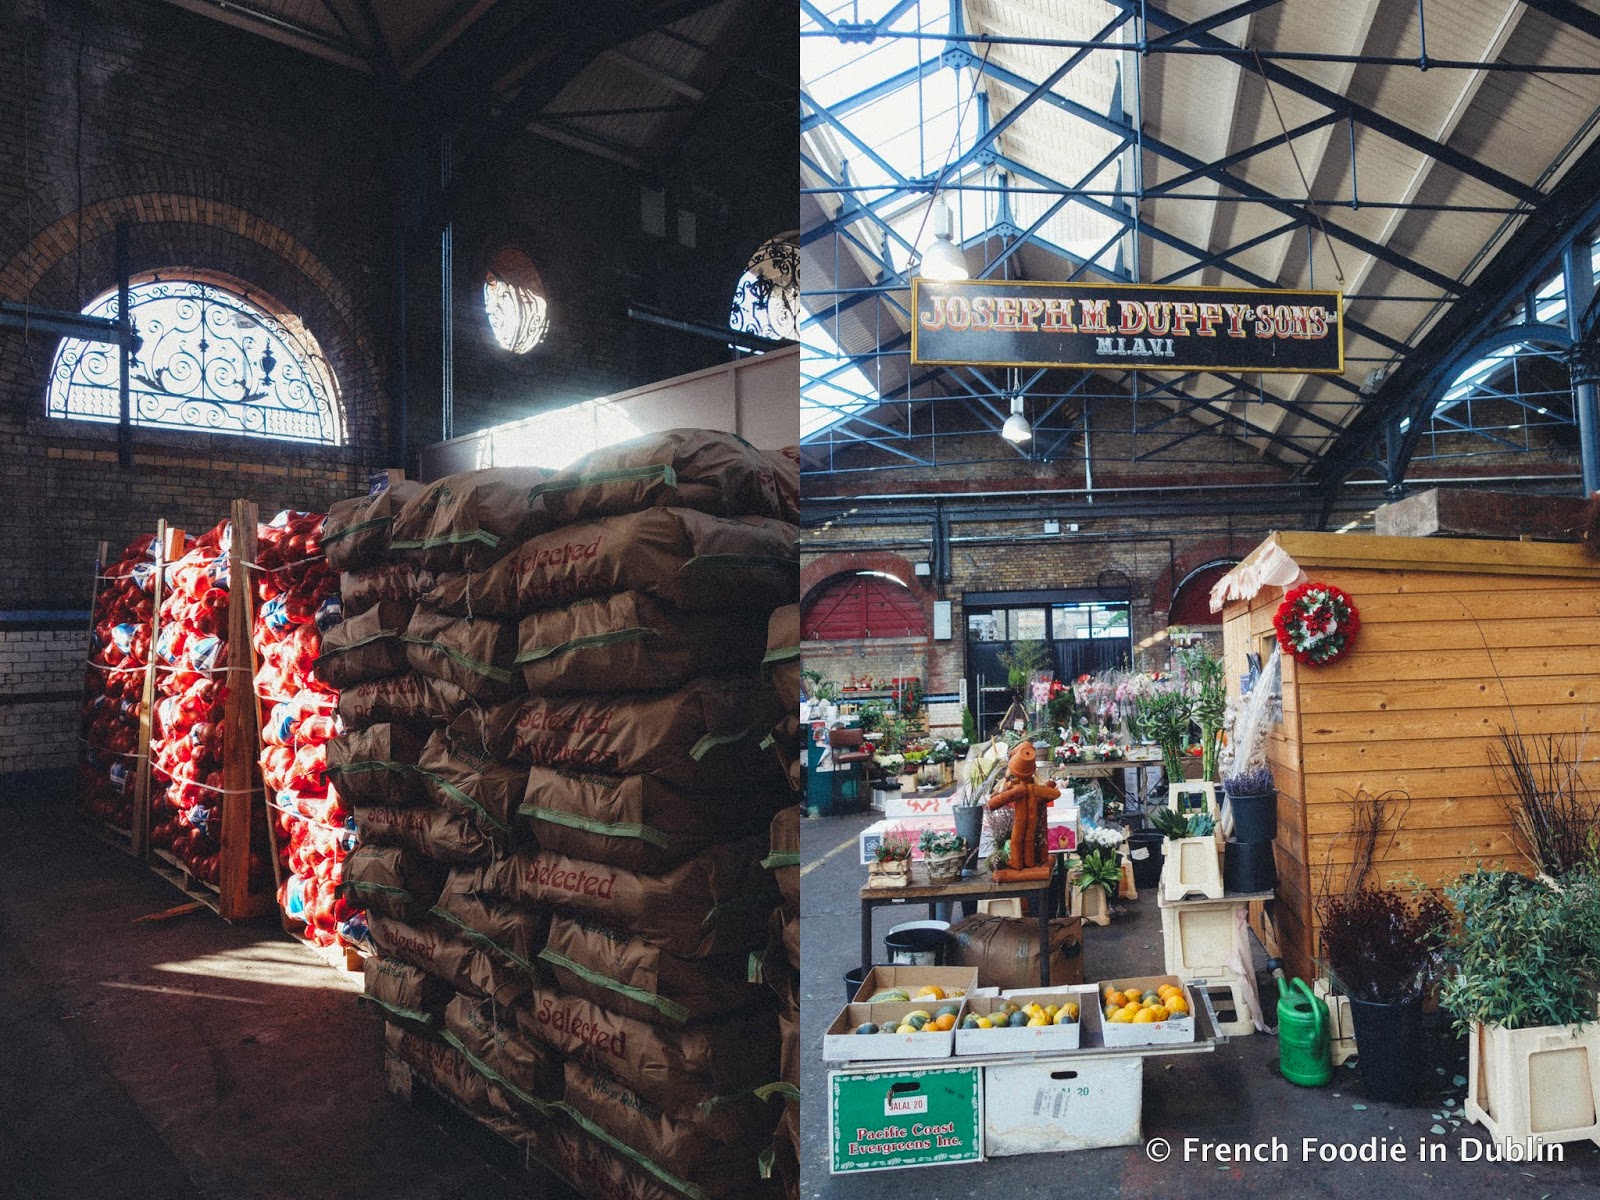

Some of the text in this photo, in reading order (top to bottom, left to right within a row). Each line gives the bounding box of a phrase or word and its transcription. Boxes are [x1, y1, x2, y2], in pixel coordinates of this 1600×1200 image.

[921, 296, 1077, 333] JOSEPH
[1117, 300, 1248, 338] DUFFY
[1255, 304, 1330, 339] SONS
[526, 860, 617, 899] Selected
[382, 924, 436, 962] Selected
[537, 999, 626, 1060] Selected
[889, 1099, 923, 1111] SALAL 20
[848, 1136, 963, 1155] Evergreens Inc.
[857, 1121, 954, 1141] Pacific Coast
